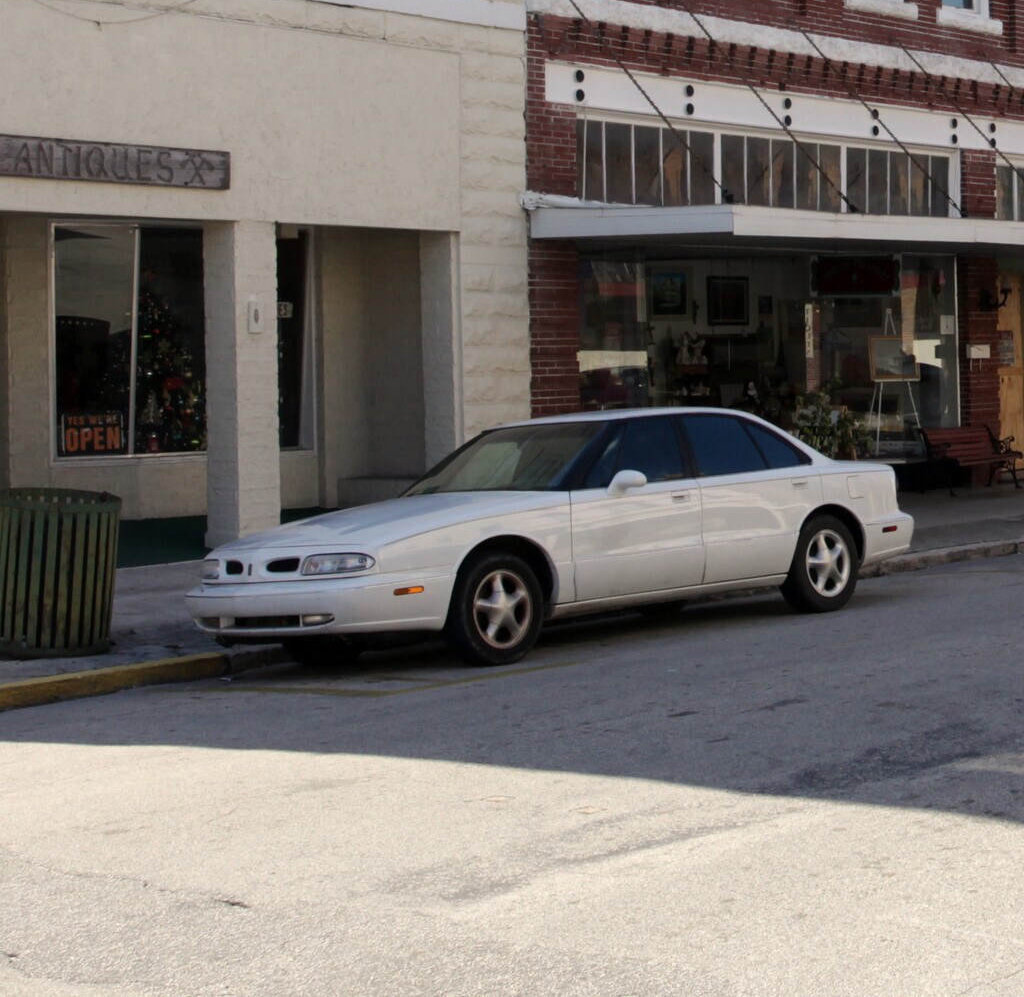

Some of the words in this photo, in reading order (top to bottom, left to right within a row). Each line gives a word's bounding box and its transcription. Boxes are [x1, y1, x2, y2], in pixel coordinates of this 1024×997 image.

[13, 142, 174, 183] ANTIQUES
[67, 415, 85, 425] YES
[66, 426, 121, 452] OPEN
